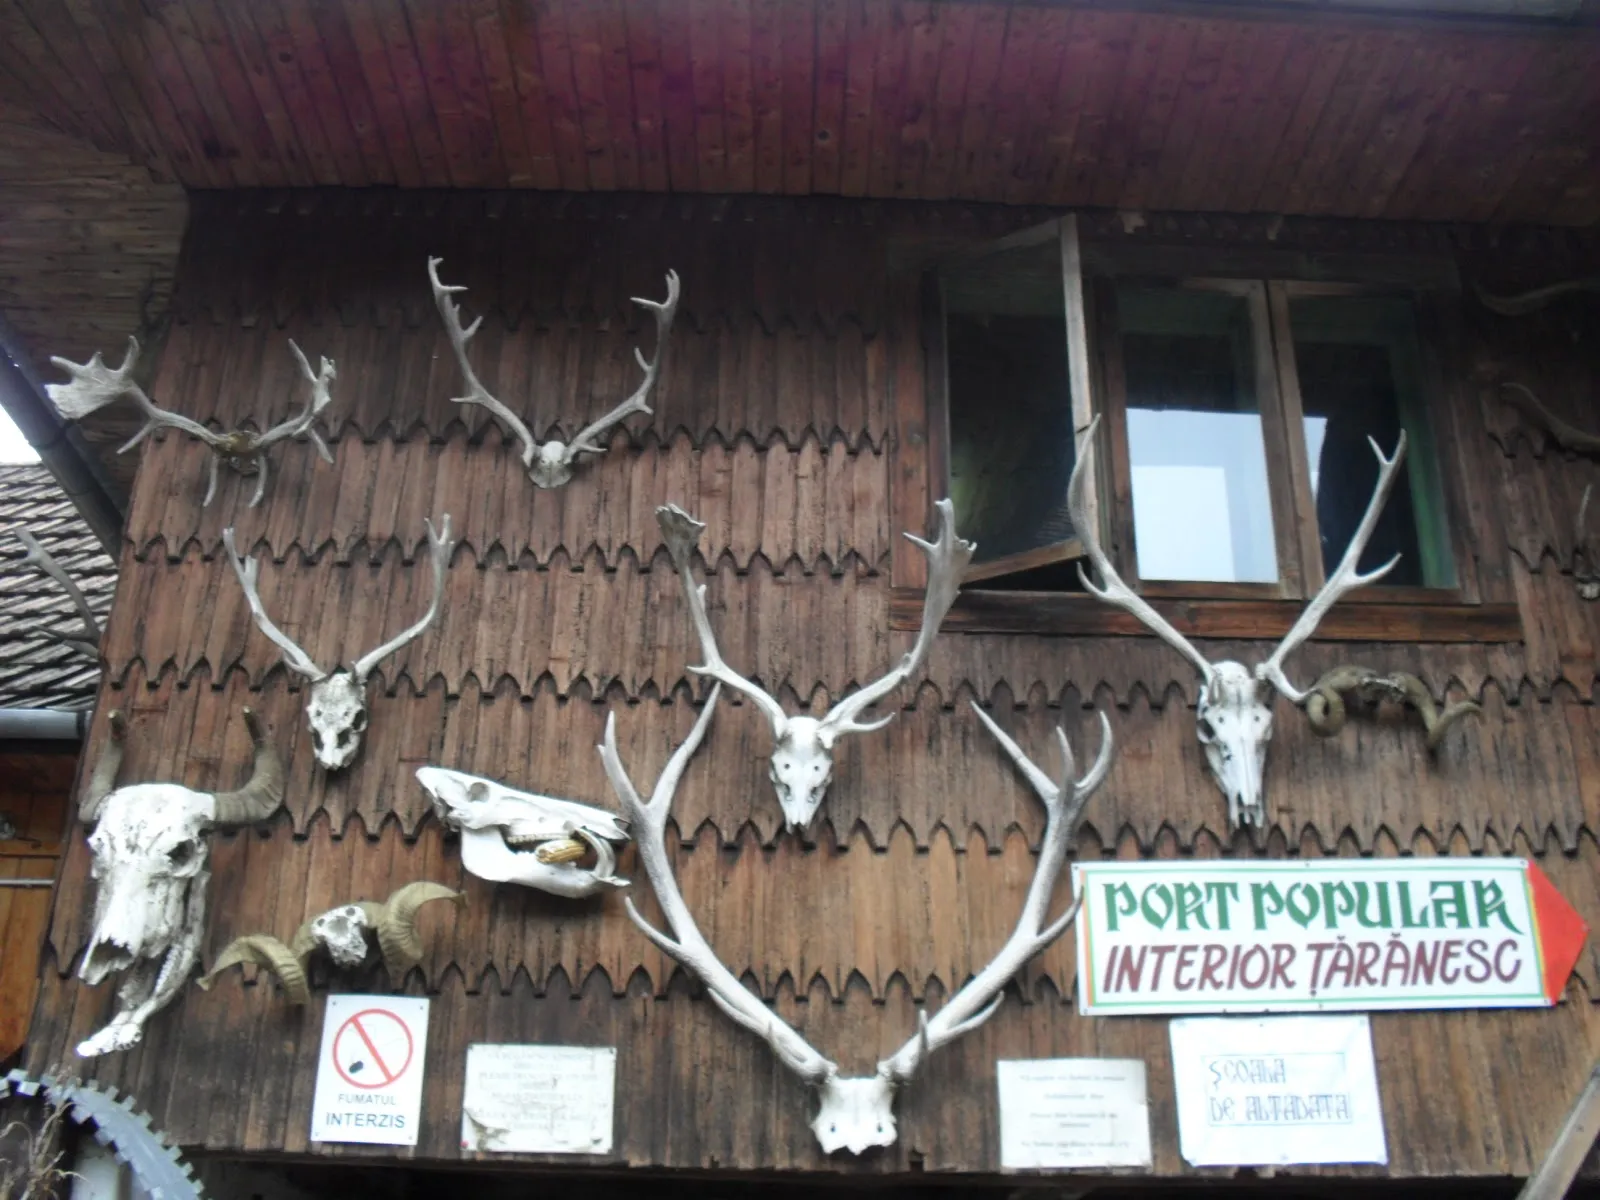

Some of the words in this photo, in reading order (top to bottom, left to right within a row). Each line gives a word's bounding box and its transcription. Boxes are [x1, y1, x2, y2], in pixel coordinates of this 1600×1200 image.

[1102, 880, 1239, 932] PORT
[1249, 878, 1525, 935] POPULAR
[1102, 942, 1297, 993] INTERIOR
[338, 1093, 397, 1106] FUMATUL
[1209, 1096, 1235, 1121] DE
[326, 1111, 406, 1128] INTERZIS
